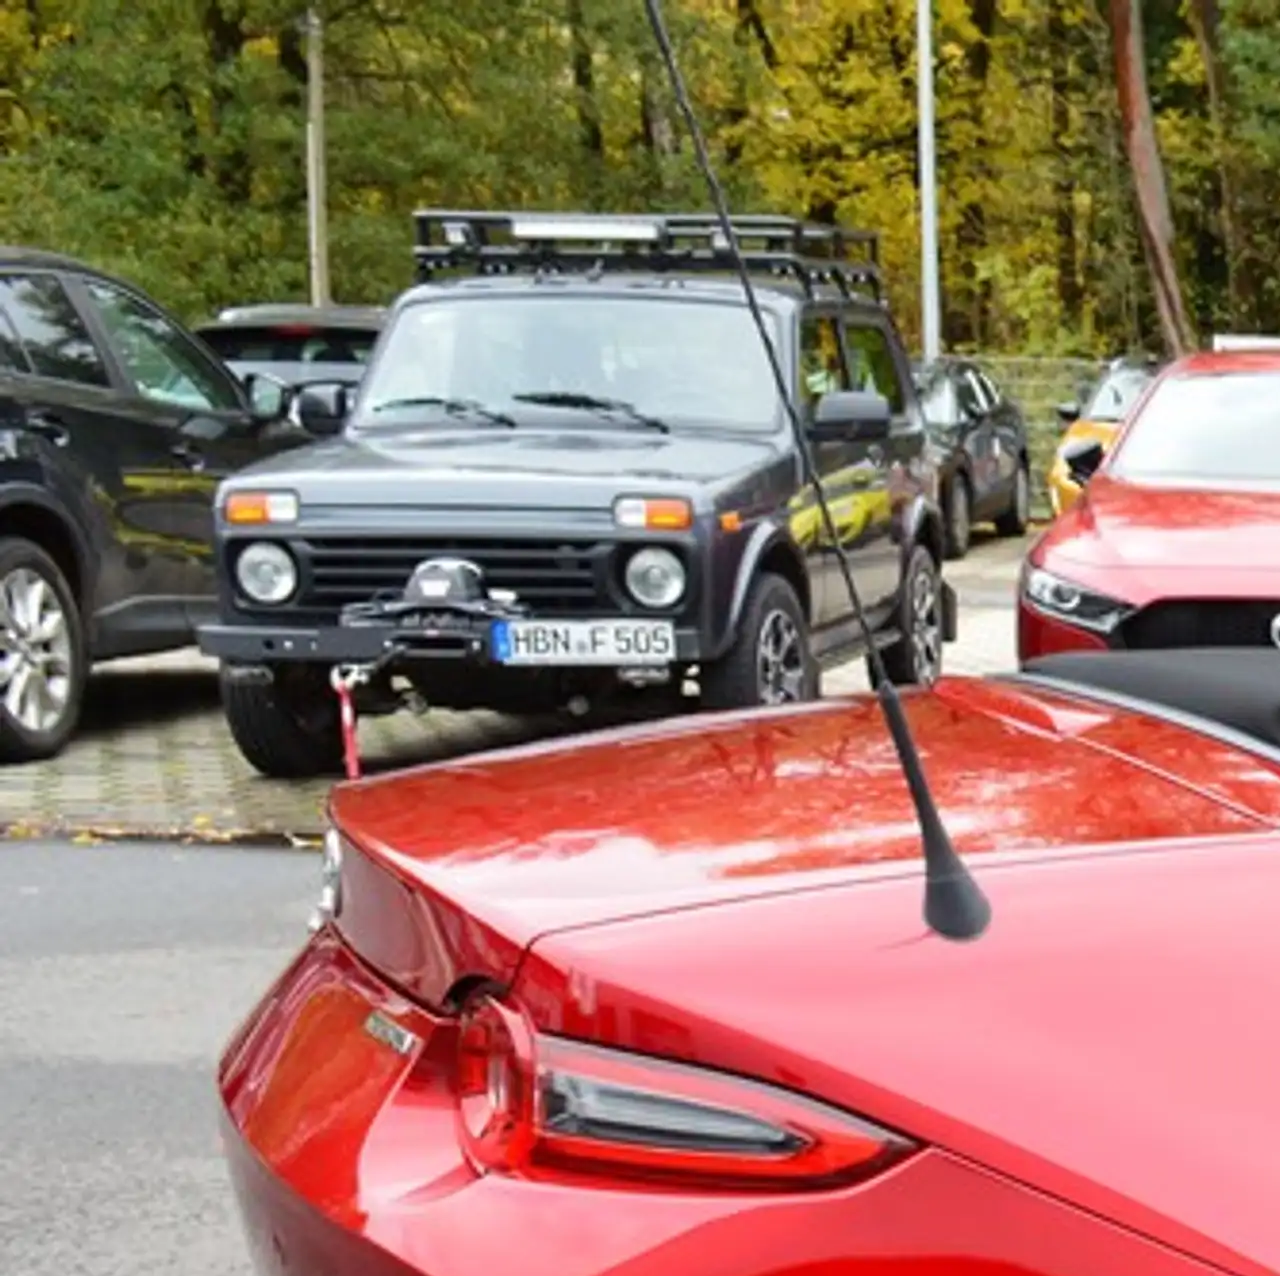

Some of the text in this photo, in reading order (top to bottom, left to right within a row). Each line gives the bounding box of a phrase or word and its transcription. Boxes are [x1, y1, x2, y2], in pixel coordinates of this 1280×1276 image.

[512, 626, 670, 655] HBN F 505
